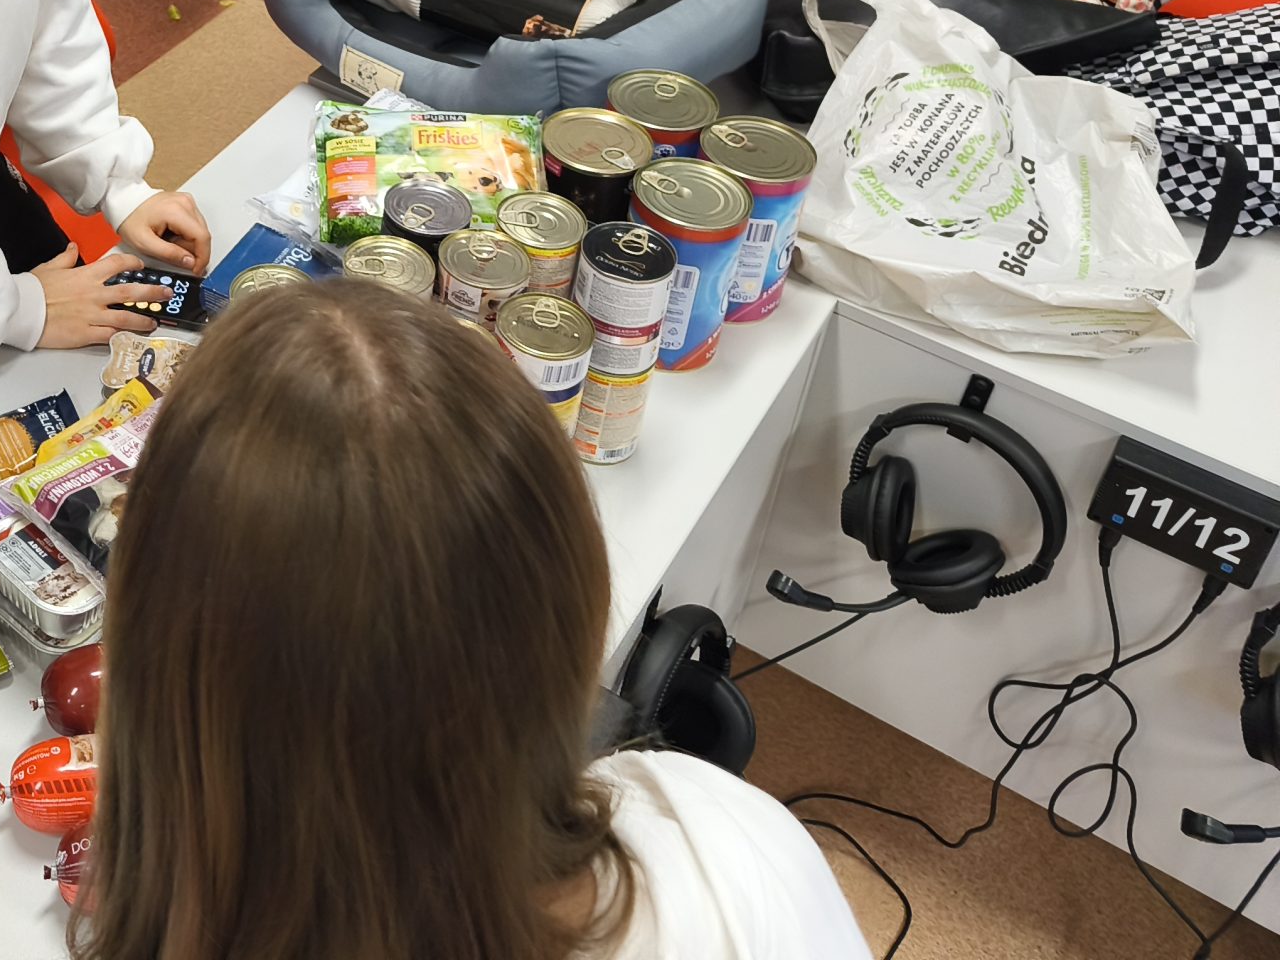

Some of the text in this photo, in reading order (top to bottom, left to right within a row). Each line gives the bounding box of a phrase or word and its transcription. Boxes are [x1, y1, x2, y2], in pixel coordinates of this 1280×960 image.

[898, 102, 928, 131] TORBA
[417, 129, 479, 146] Friskies
[888, 93, 955, 173] JEST WYKONANA
[905, 102, 965, 176] Z MATERIAŁÓW
[915, 104, 983, 189] POCHODZĄCYCH
[956, 134, 986, 165] 80%
[104, 462, 115, 471] 2
[47, 470, 101, 504] WOŁOWINA
[1125, 486, 1250, 565] 11/12
[28, 540, 48, 558] ADULT
[72, 837, 94, 855] DO
